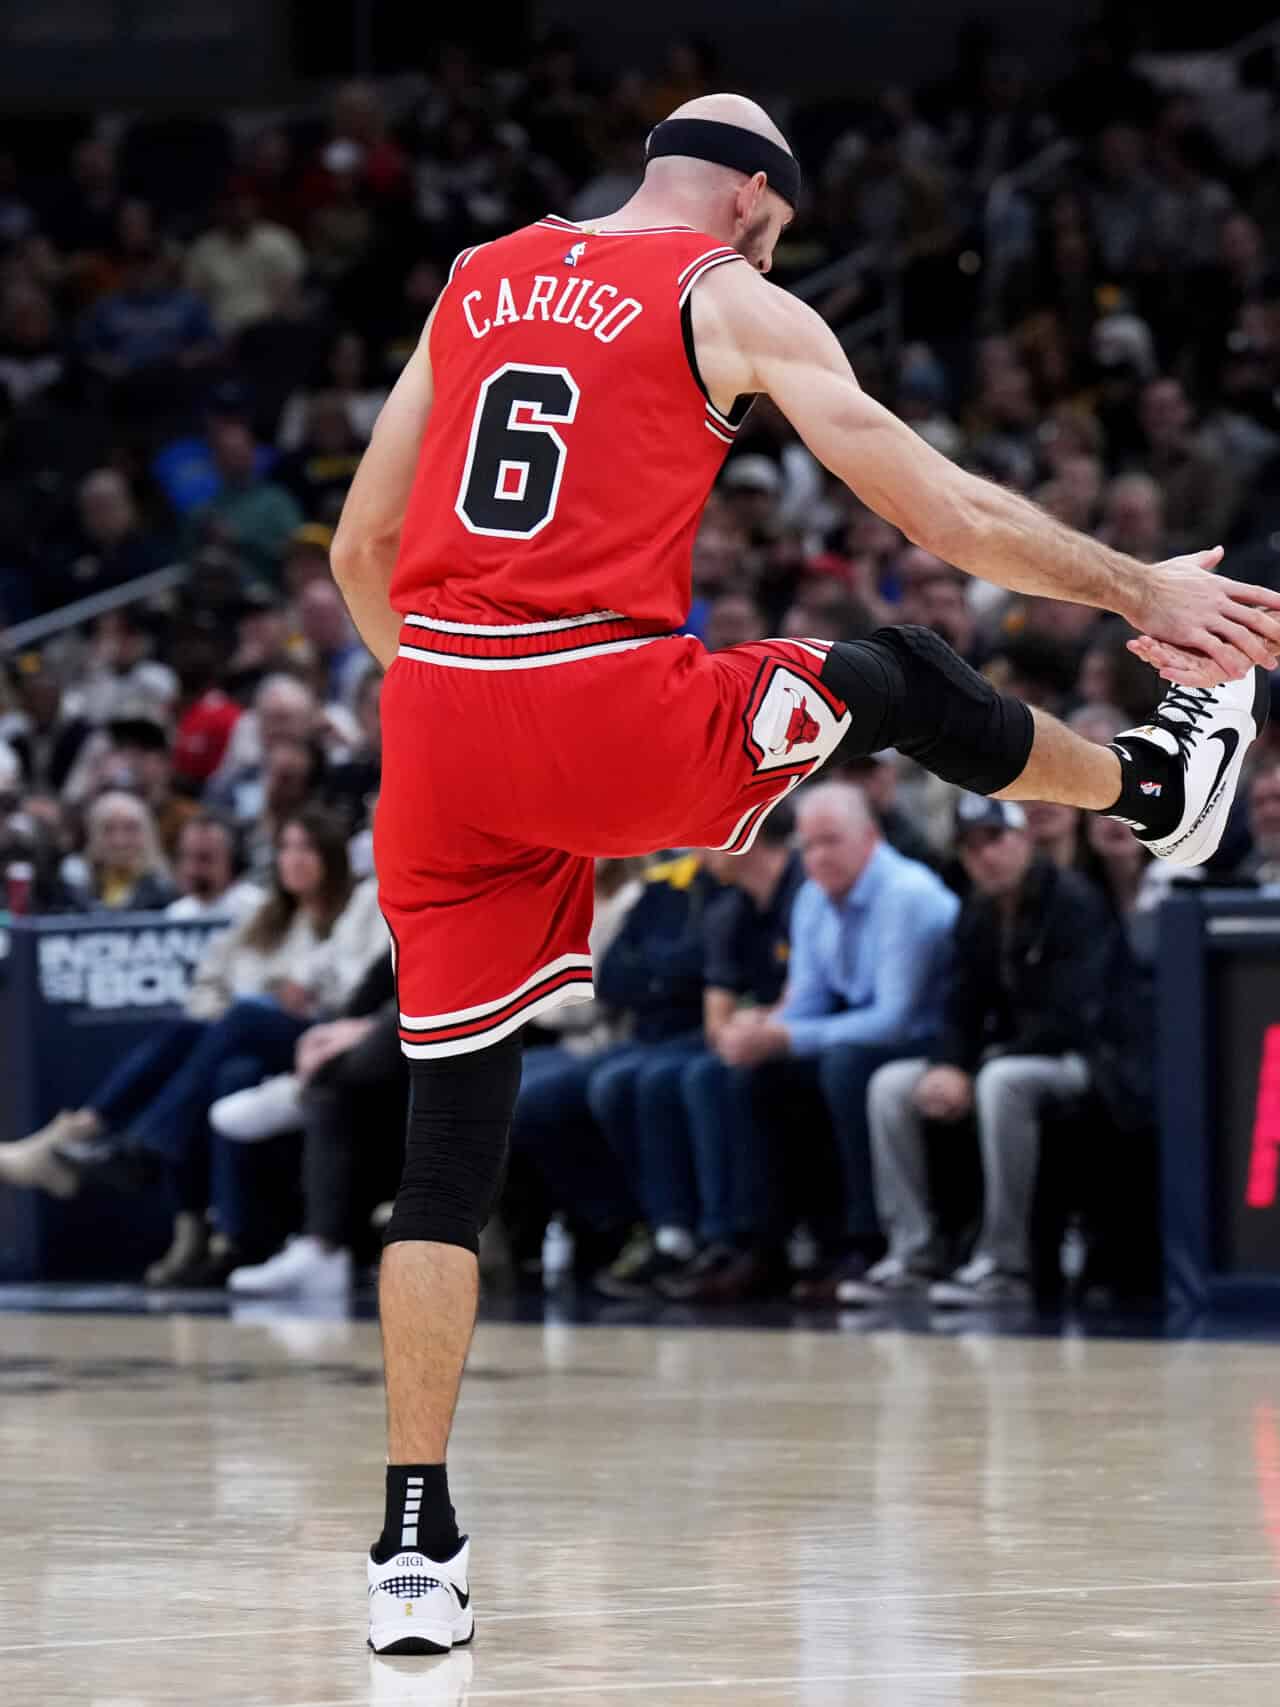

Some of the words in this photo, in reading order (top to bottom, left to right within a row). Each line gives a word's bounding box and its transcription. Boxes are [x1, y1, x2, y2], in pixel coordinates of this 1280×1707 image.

[462, 274, 643, 344] CARUSO
[454, 361, 581, 540] 6
[396, 1556, 424, 1567] GIGI
